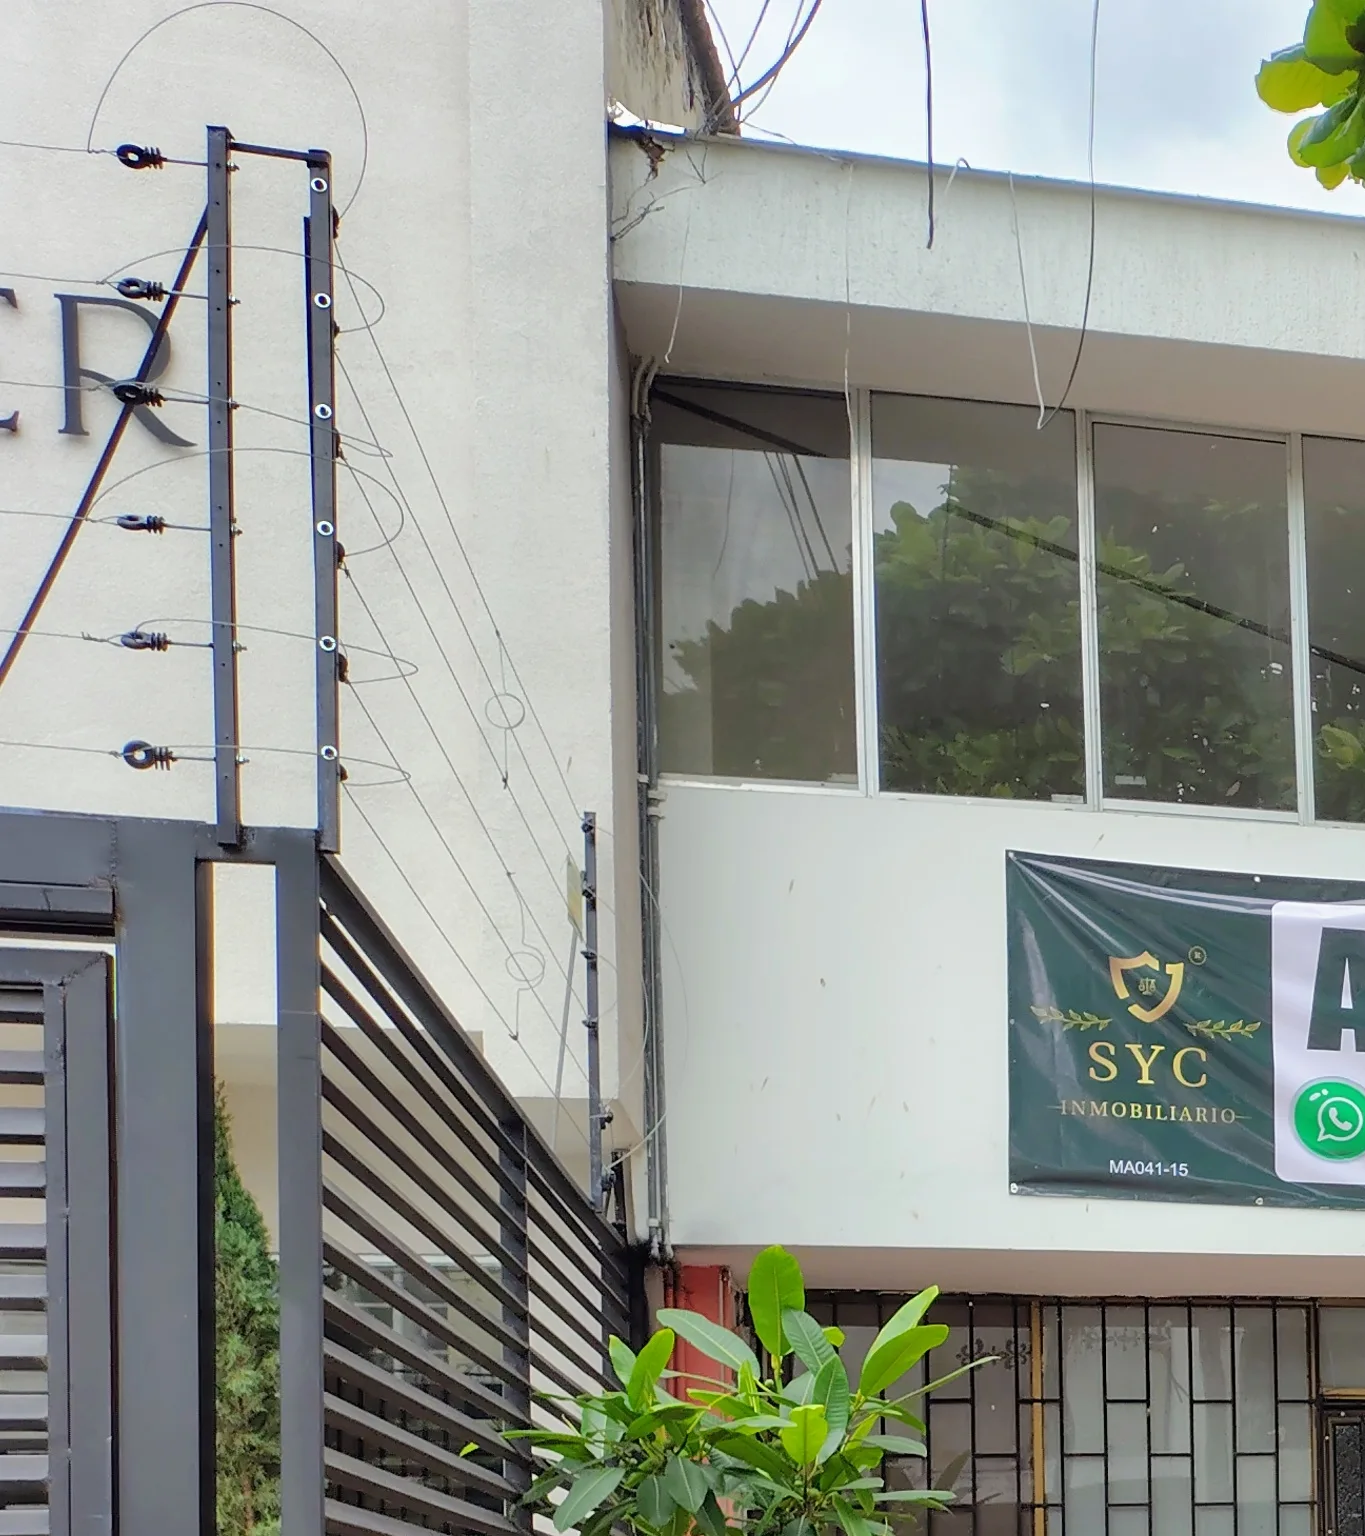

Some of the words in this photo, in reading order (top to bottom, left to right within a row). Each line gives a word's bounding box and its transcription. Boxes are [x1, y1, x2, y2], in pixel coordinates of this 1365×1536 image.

[0, 287, 198, 447] R
[1088, 1041, 1208, 1088] SYC
[1060, 1099, 1237, 1125] INMOBILIARIO
[1108, 1160, 1189, 1178] MA041-15
